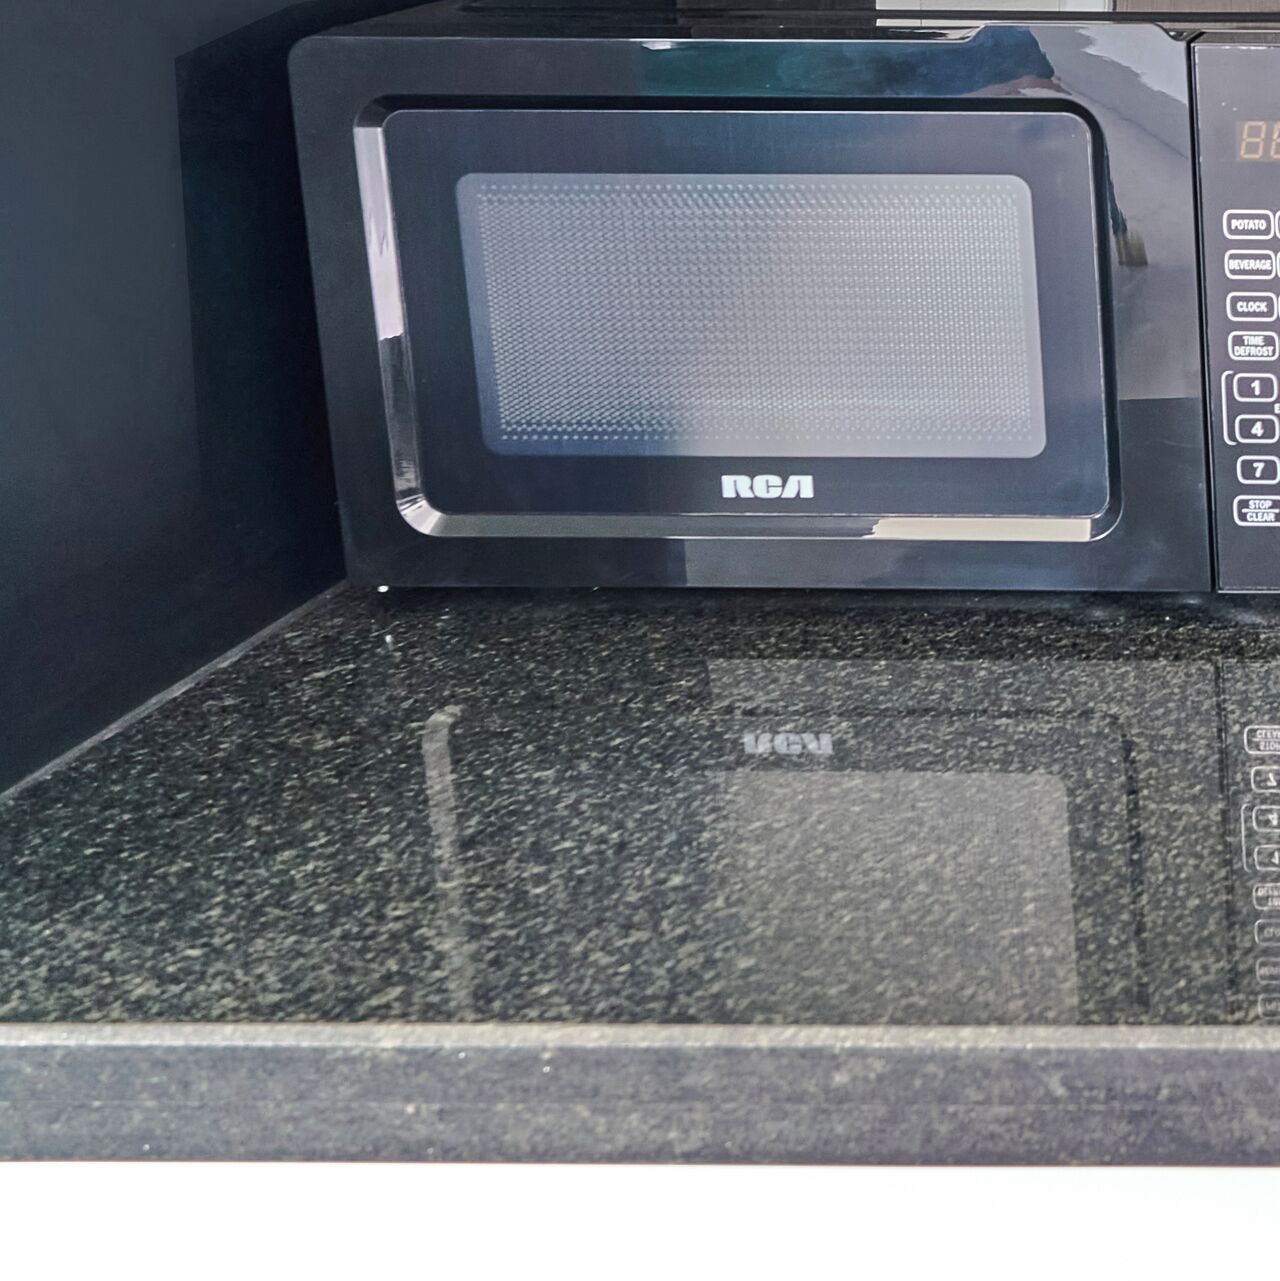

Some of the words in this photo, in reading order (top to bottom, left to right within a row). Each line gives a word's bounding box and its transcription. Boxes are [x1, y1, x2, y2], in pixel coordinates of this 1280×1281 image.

[1231, 219, 1266, 230] POTATO
[1229, 259, 1272, 270] BEVERAGE
[1237, 301, 1267, 312] CLOCK
[1242, 336, 1264, 345] TIME
[1234, 346, 1273, 356] DEFROST
[1251, 380, 1260, 395] 1
[1251, 421, 1263, 437] 4
[1253, 463, 1264, 477] 7
[721, 474, 814, 498] RCA
[1249, 500, 1272, 509] STOP
[1247, 512, 1275, 522] CLEAR
